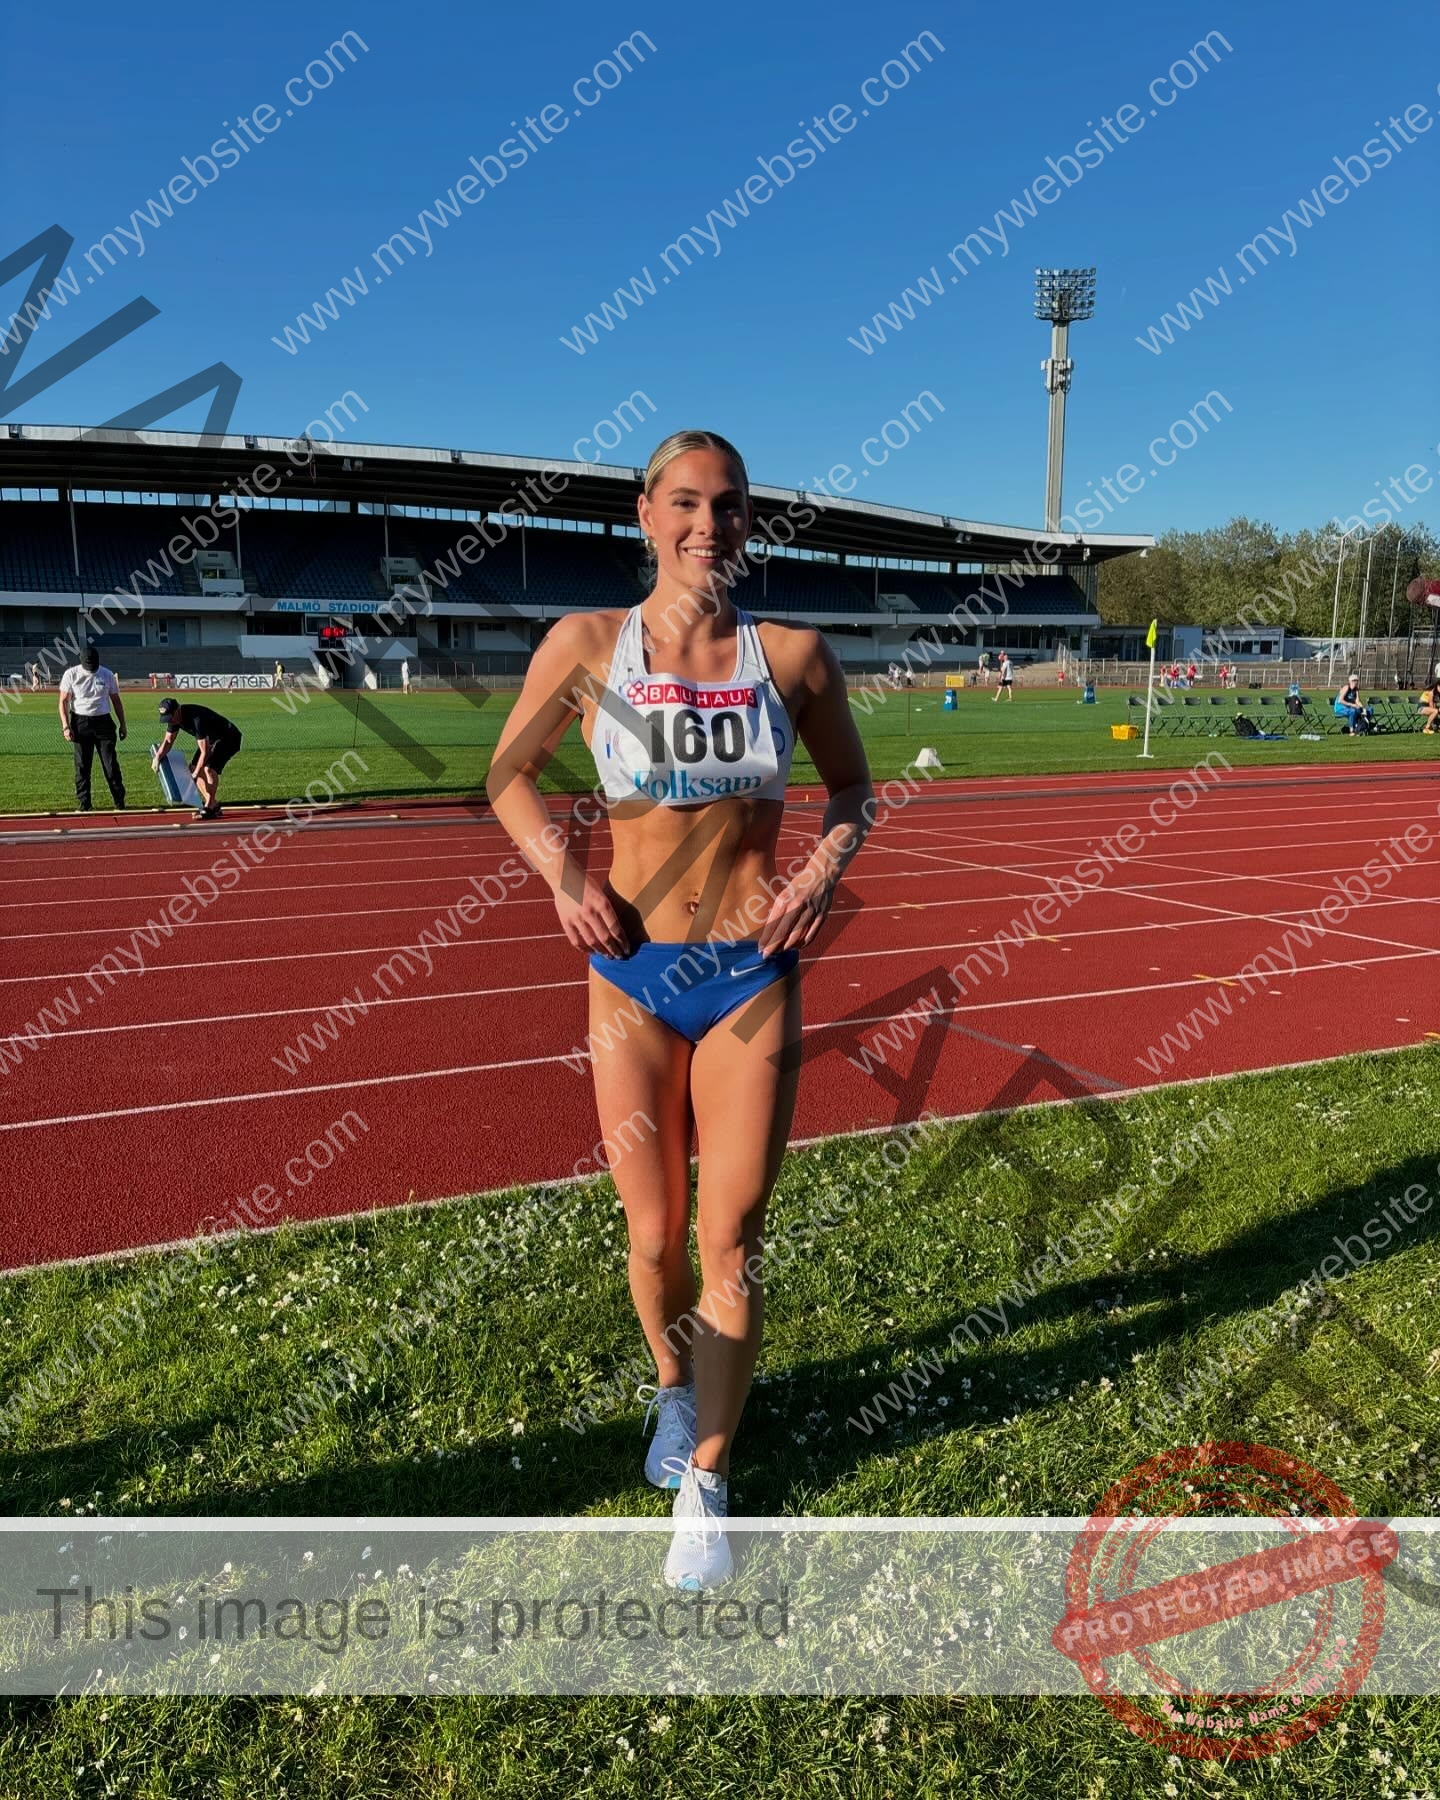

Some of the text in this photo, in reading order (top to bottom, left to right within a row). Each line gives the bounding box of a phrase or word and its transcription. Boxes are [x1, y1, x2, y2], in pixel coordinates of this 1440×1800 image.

[277, 600, 379, 613] MALMÖ STADION
[648, 685, 757, 707] BAUHAUS
[645, 709, 746, 764] 160
[632, 769, 762, 800] Folksam
